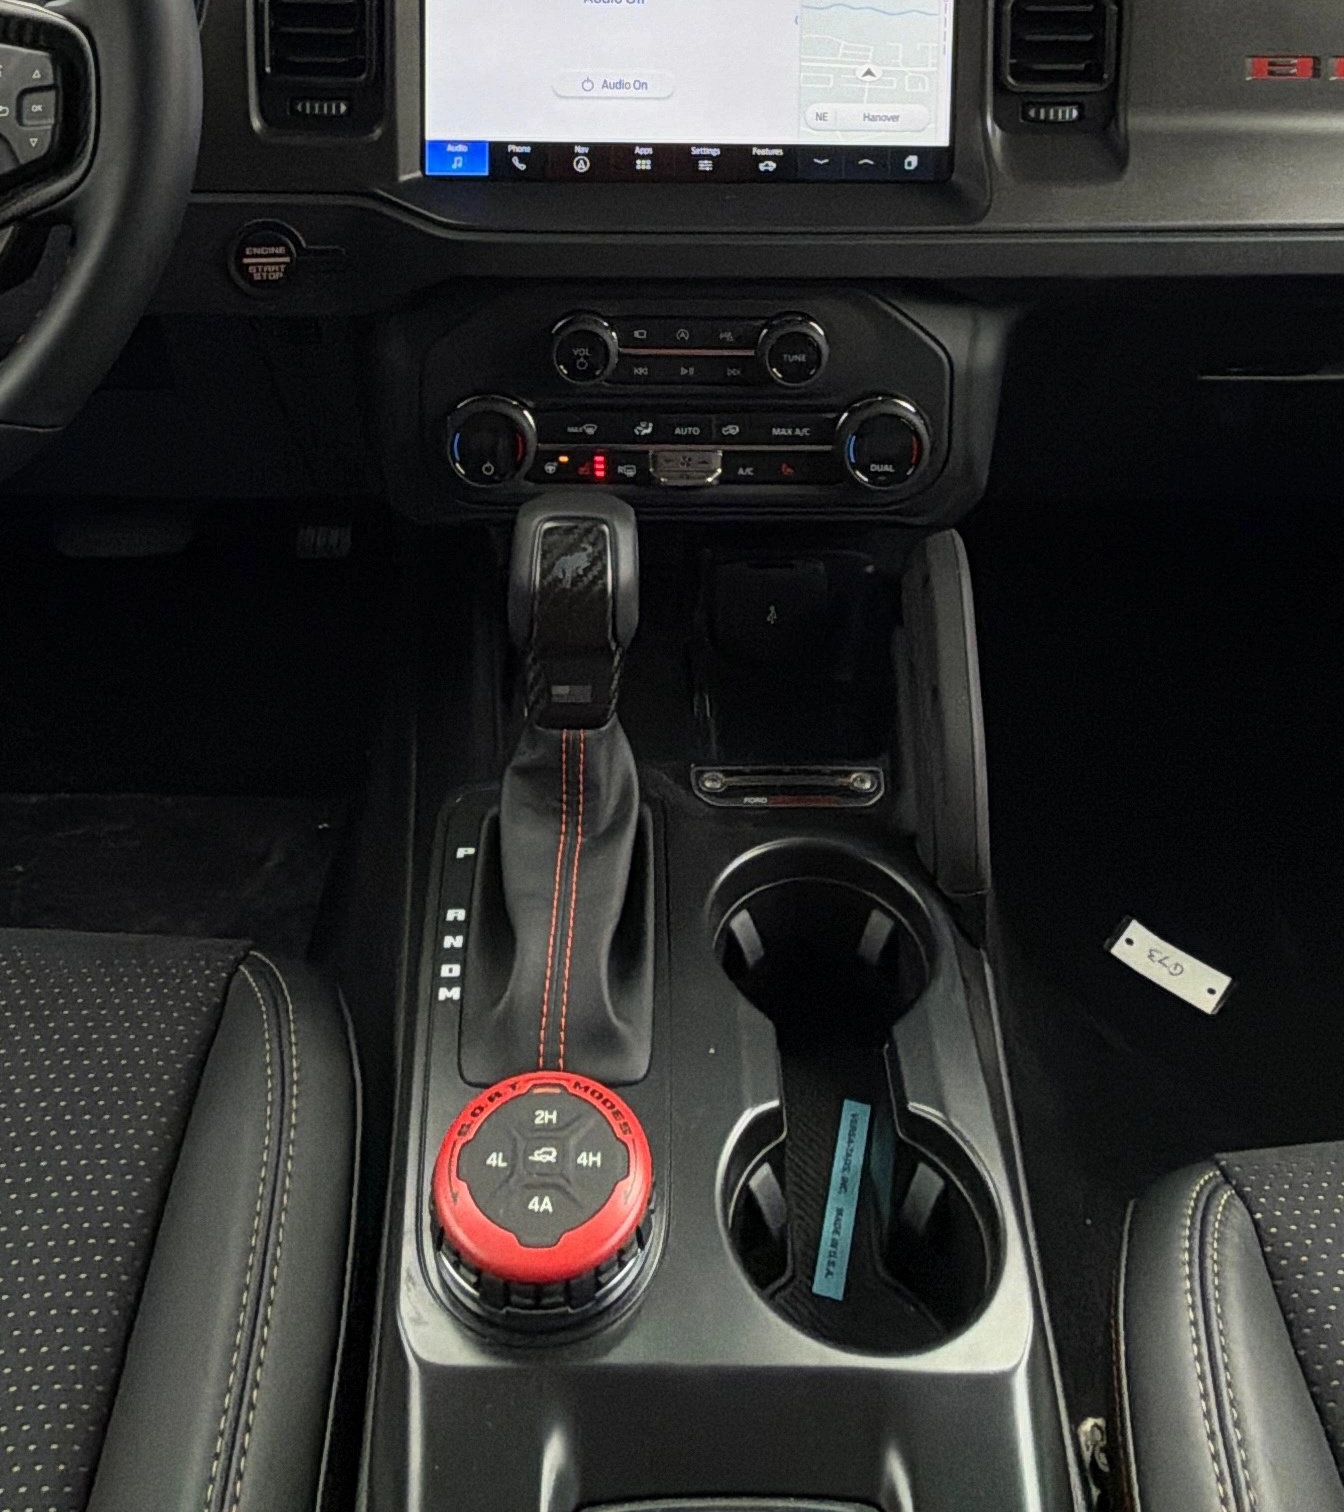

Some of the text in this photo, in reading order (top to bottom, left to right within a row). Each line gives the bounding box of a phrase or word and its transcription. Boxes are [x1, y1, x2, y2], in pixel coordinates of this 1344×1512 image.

[601, 79, 648, 90] Audio On
[815, 112, 829, 122] NE
[863, 112, 900, 123] Hanover
[446, 144, 468, 153] Audio
[508, 144, 531, 153] Phone
[574, 145, 589, 154] Nav
[634, 146, 653, 155] Apps
[783, 354, 806, 362] TUNE
[675, 427, 700, 435] AUTO
[772, 427, 792, 436] MAX
[870, 464, 895, 472] DUAL
[456, 847, 475, 859] P
[443, 935, 463, 948] N
[440, 963, 461, 977] D
[438, 986, 461, 1001] M
[573, 1081, 632, 1135] MODES
[534, 1110, 557, 1124] 2H
[486, 1151, 508, 1168] 4L
[576, 1151, 602, 1168] 4H
[528, 1196, 553, 1213] 4A
